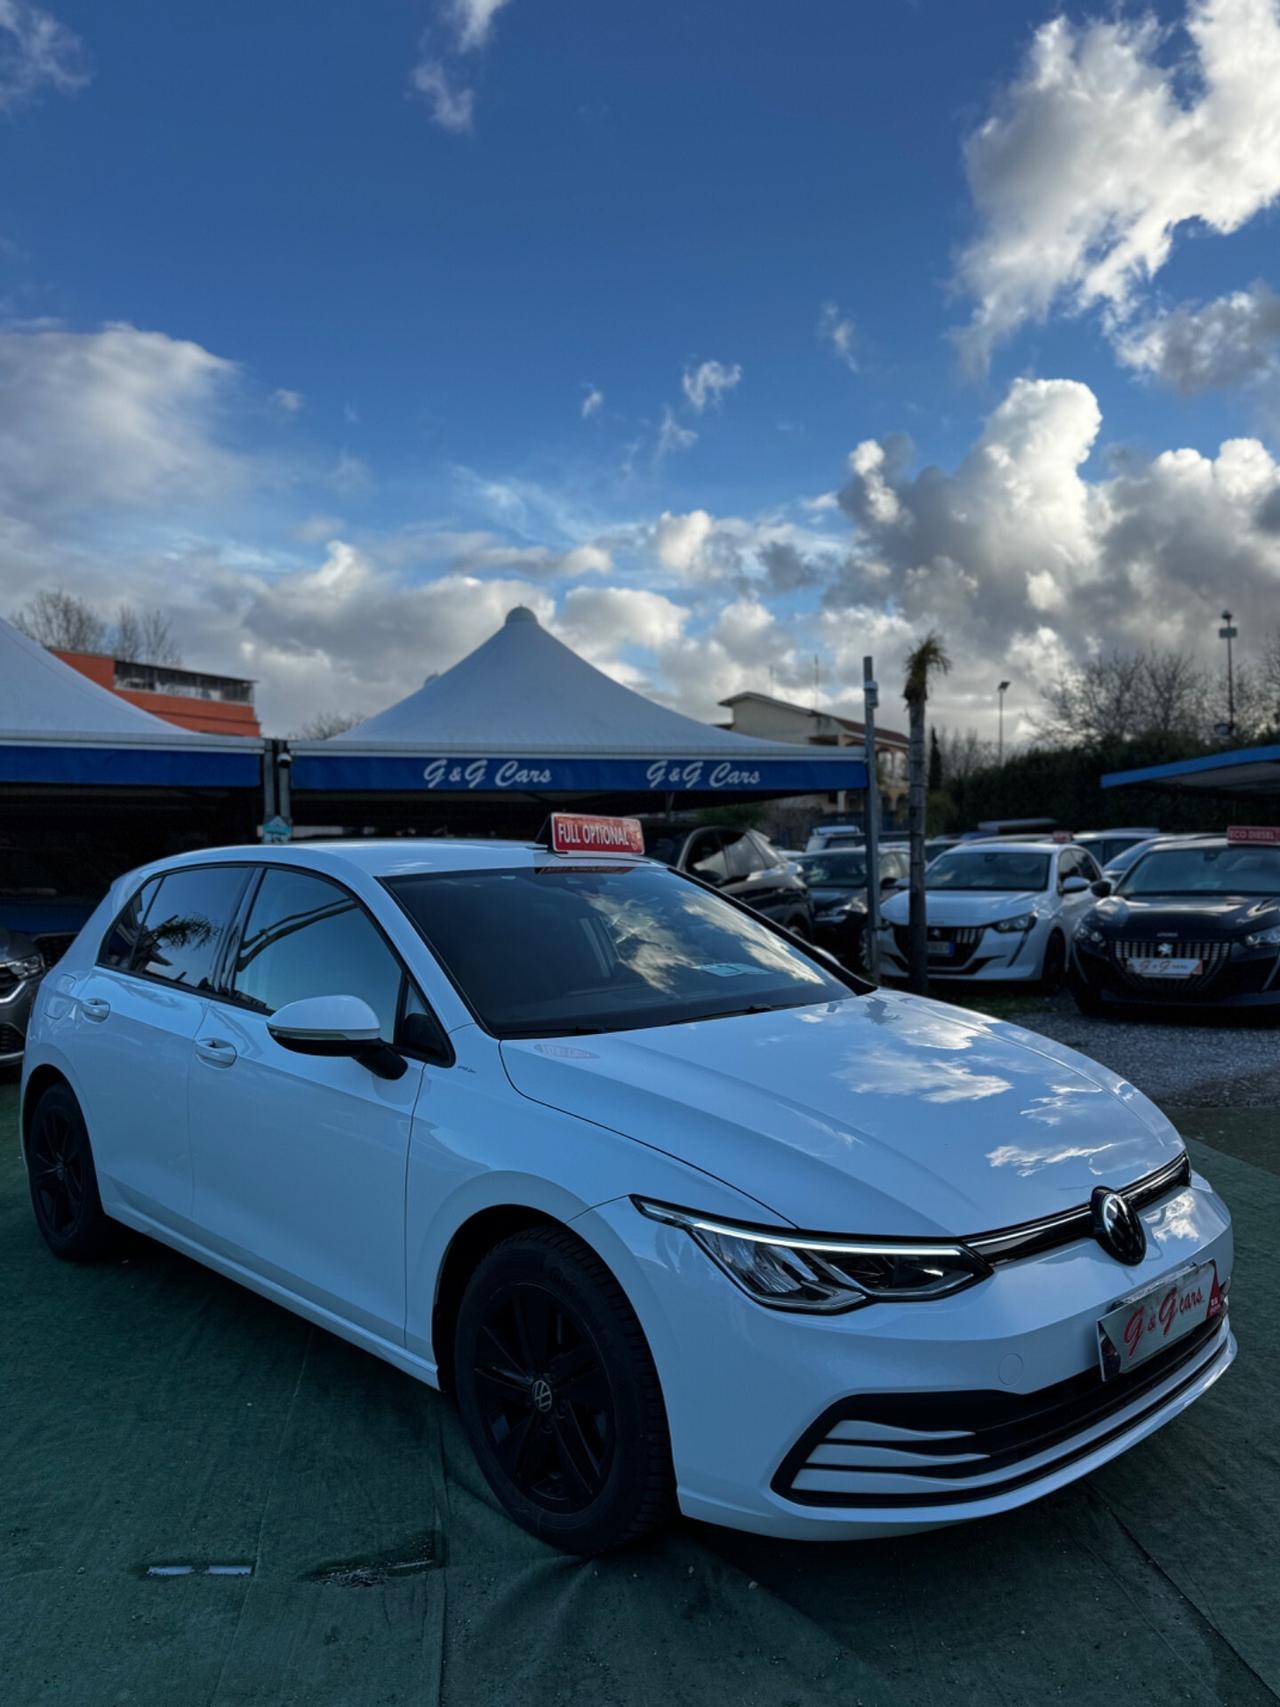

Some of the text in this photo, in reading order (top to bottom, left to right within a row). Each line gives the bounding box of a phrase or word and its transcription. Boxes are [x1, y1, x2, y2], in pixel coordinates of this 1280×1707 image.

[494, 760, 552, 788] Cars
[709, 762, 761, 788] Cars
[557, 822, 581, 845] FULL
[582, 825, 629, 846] OPTIONAL
